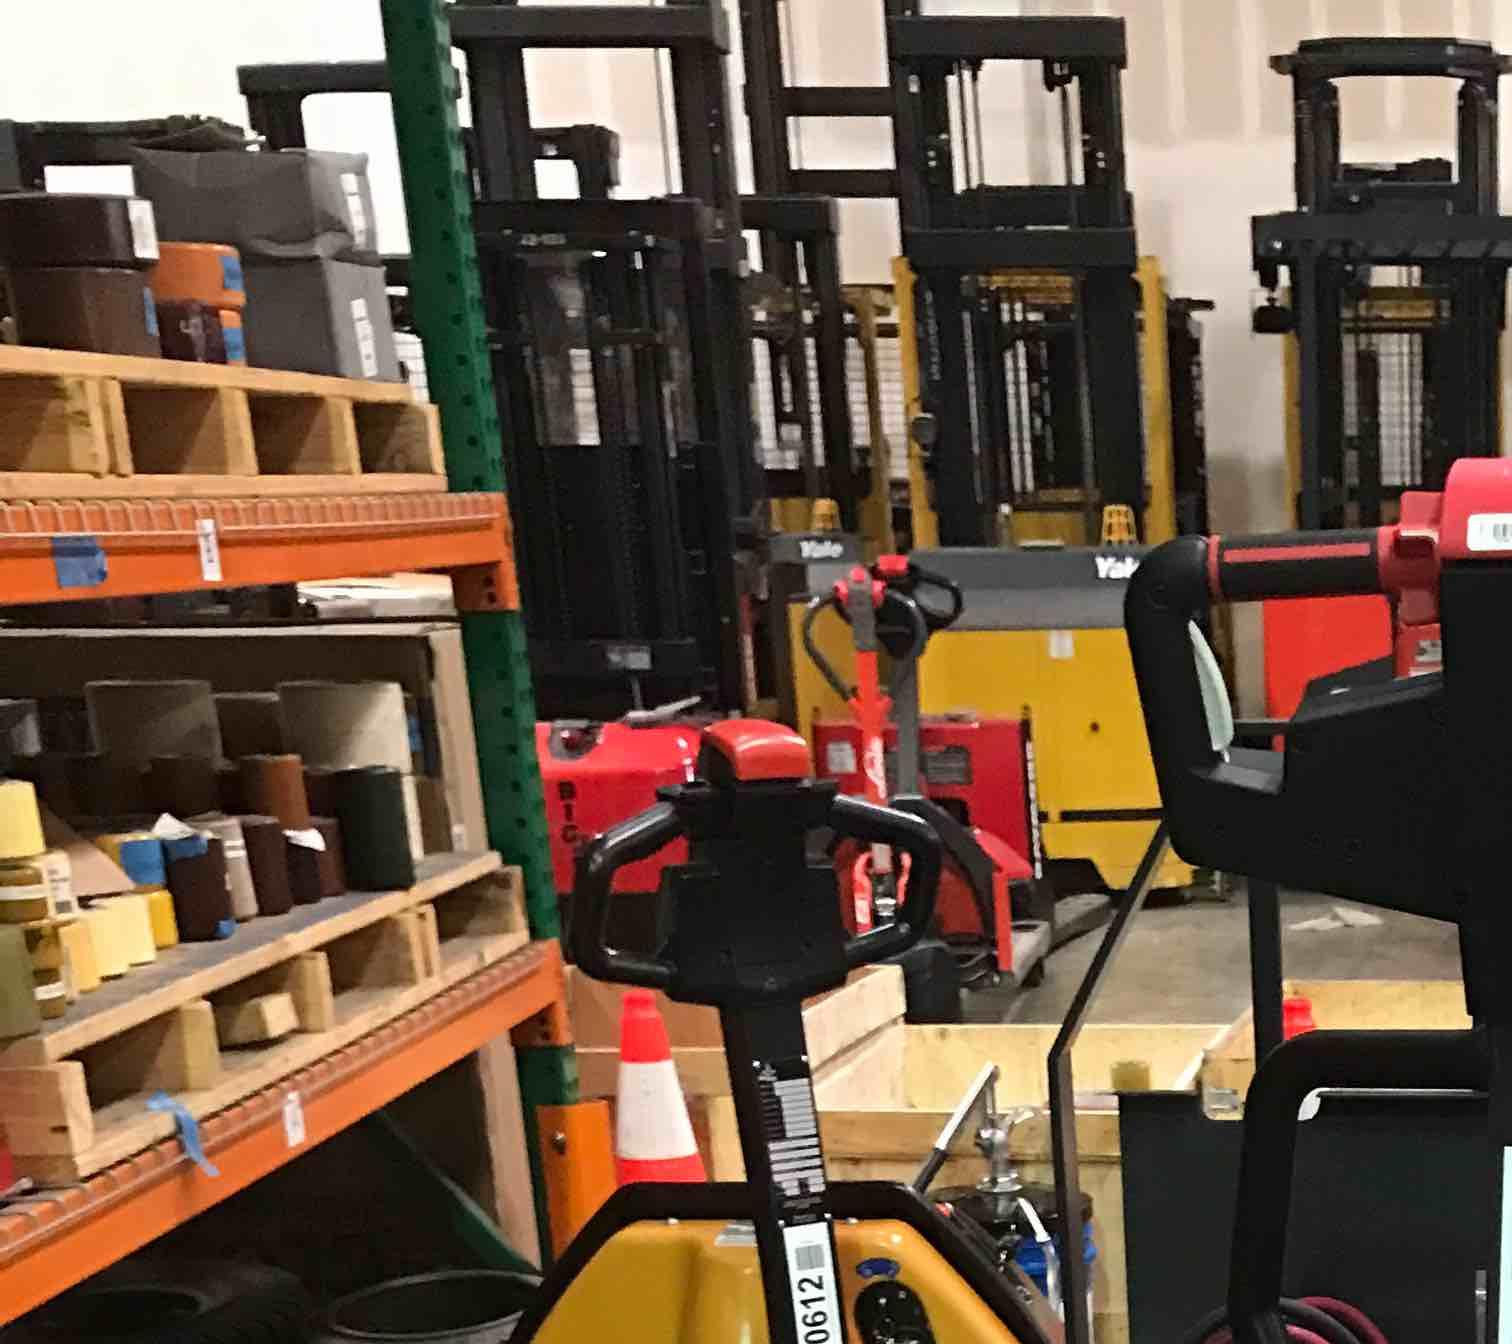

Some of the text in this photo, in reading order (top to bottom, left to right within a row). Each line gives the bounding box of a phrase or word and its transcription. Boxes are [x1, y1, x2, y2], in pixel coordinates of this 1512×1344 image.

[800, 541, 844, 558] Yale
[1095, 556, 1140, 579] Yal
[797, 1275, 831, 1344] 0612
